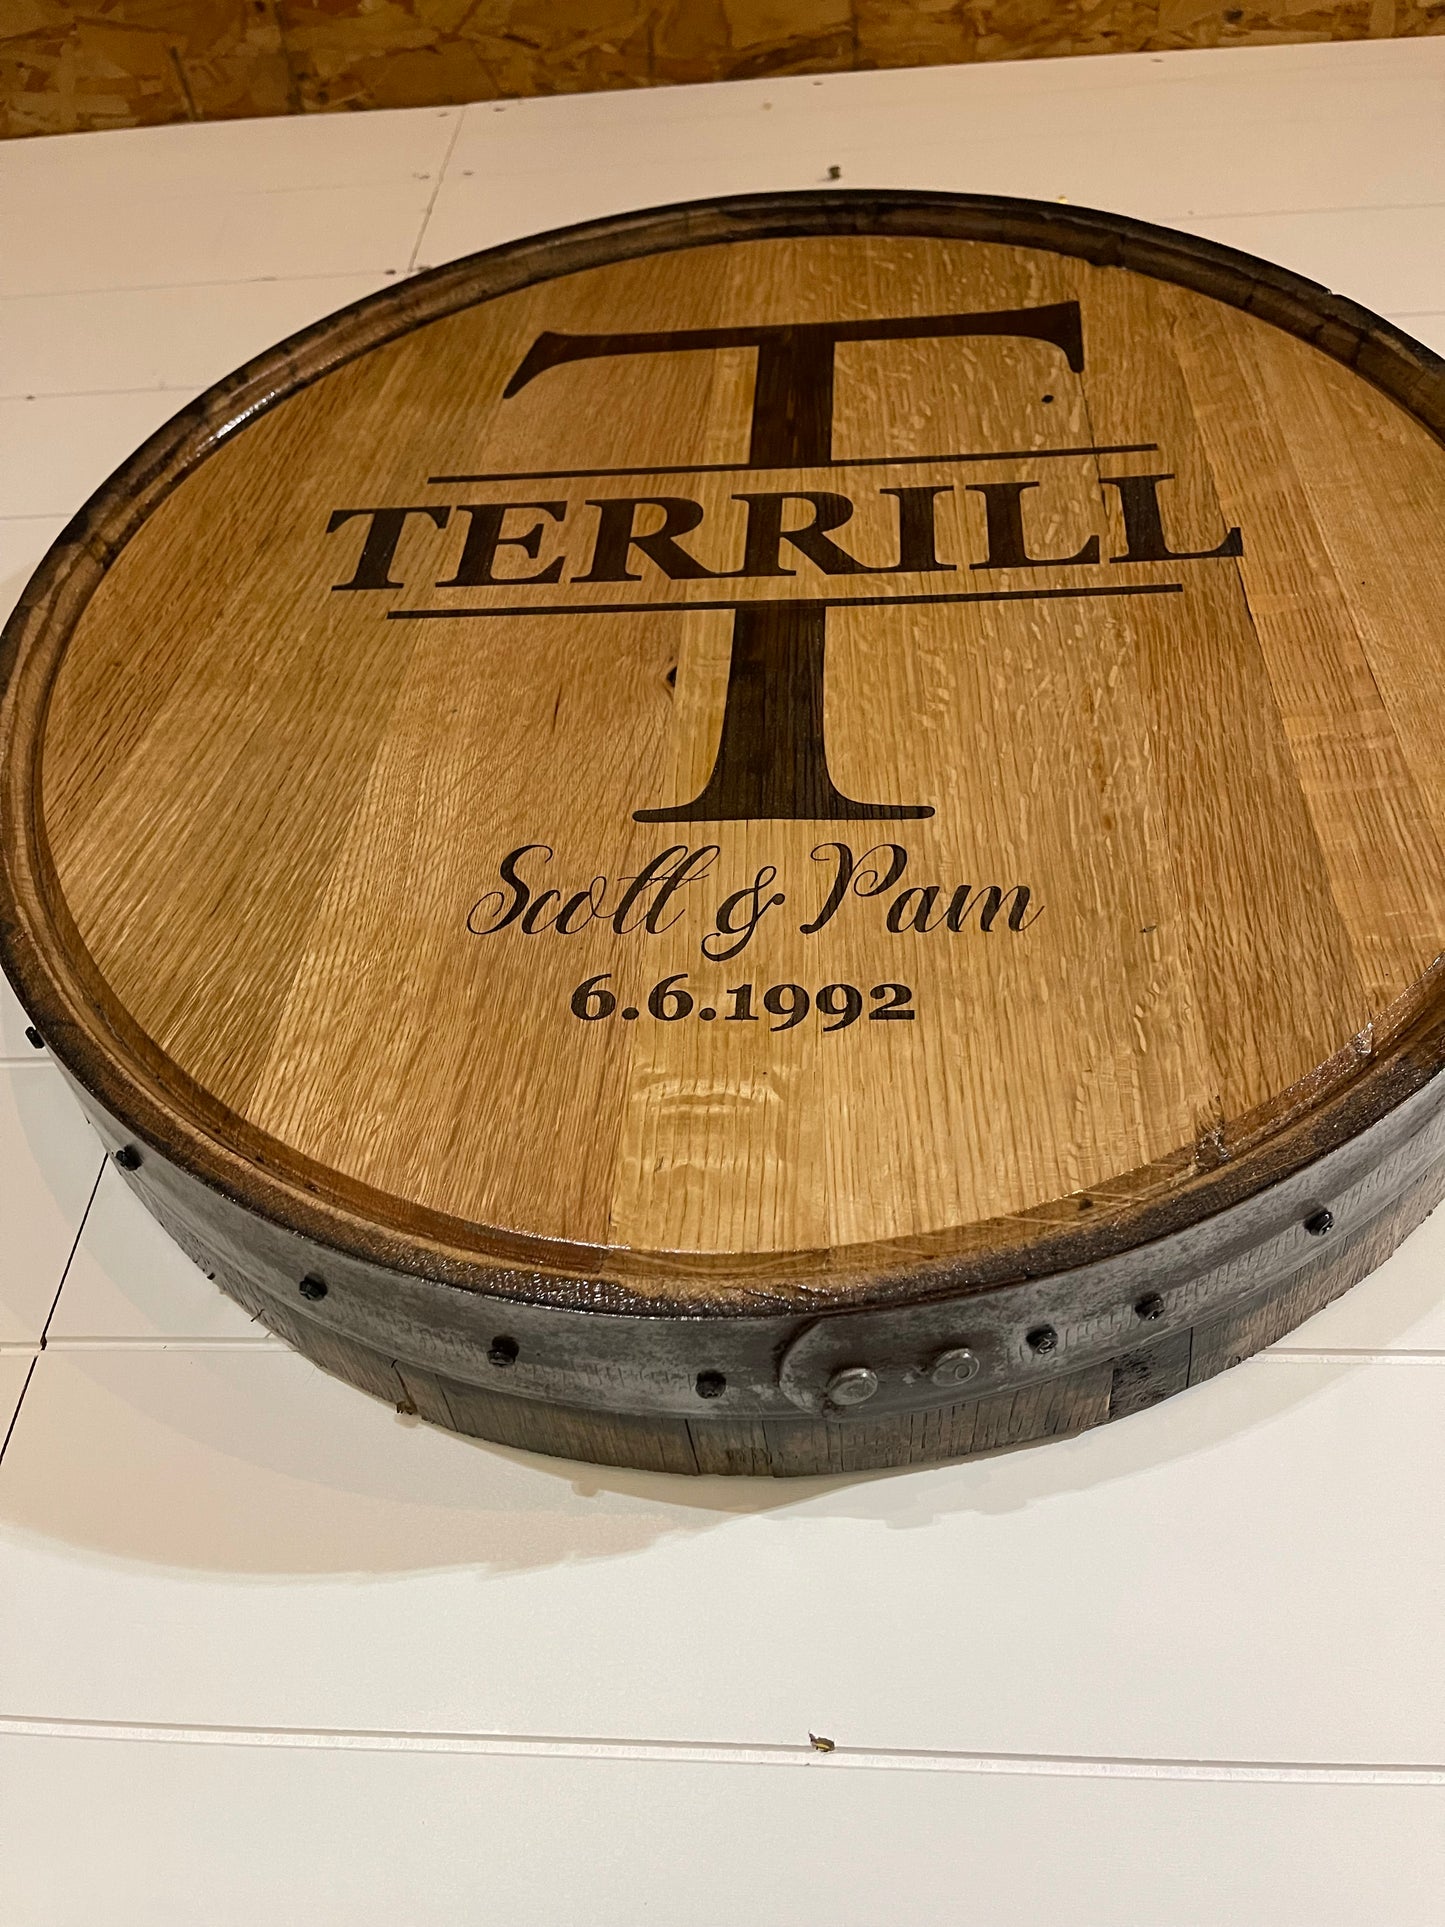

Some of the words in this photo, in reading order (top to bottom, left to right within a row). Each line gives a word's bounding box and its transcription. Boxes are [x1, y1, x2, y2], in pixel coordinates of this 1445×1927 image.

[326, 474, 1243, 591] TERRILL
[503, 301, 1086, 822] T
[467, 844, 720, 935] Scott
[701, 866, 785, 961] &
[800, 842, 1045, 935] Pam
[571, 973, 915, 1032] 6.6.1992
